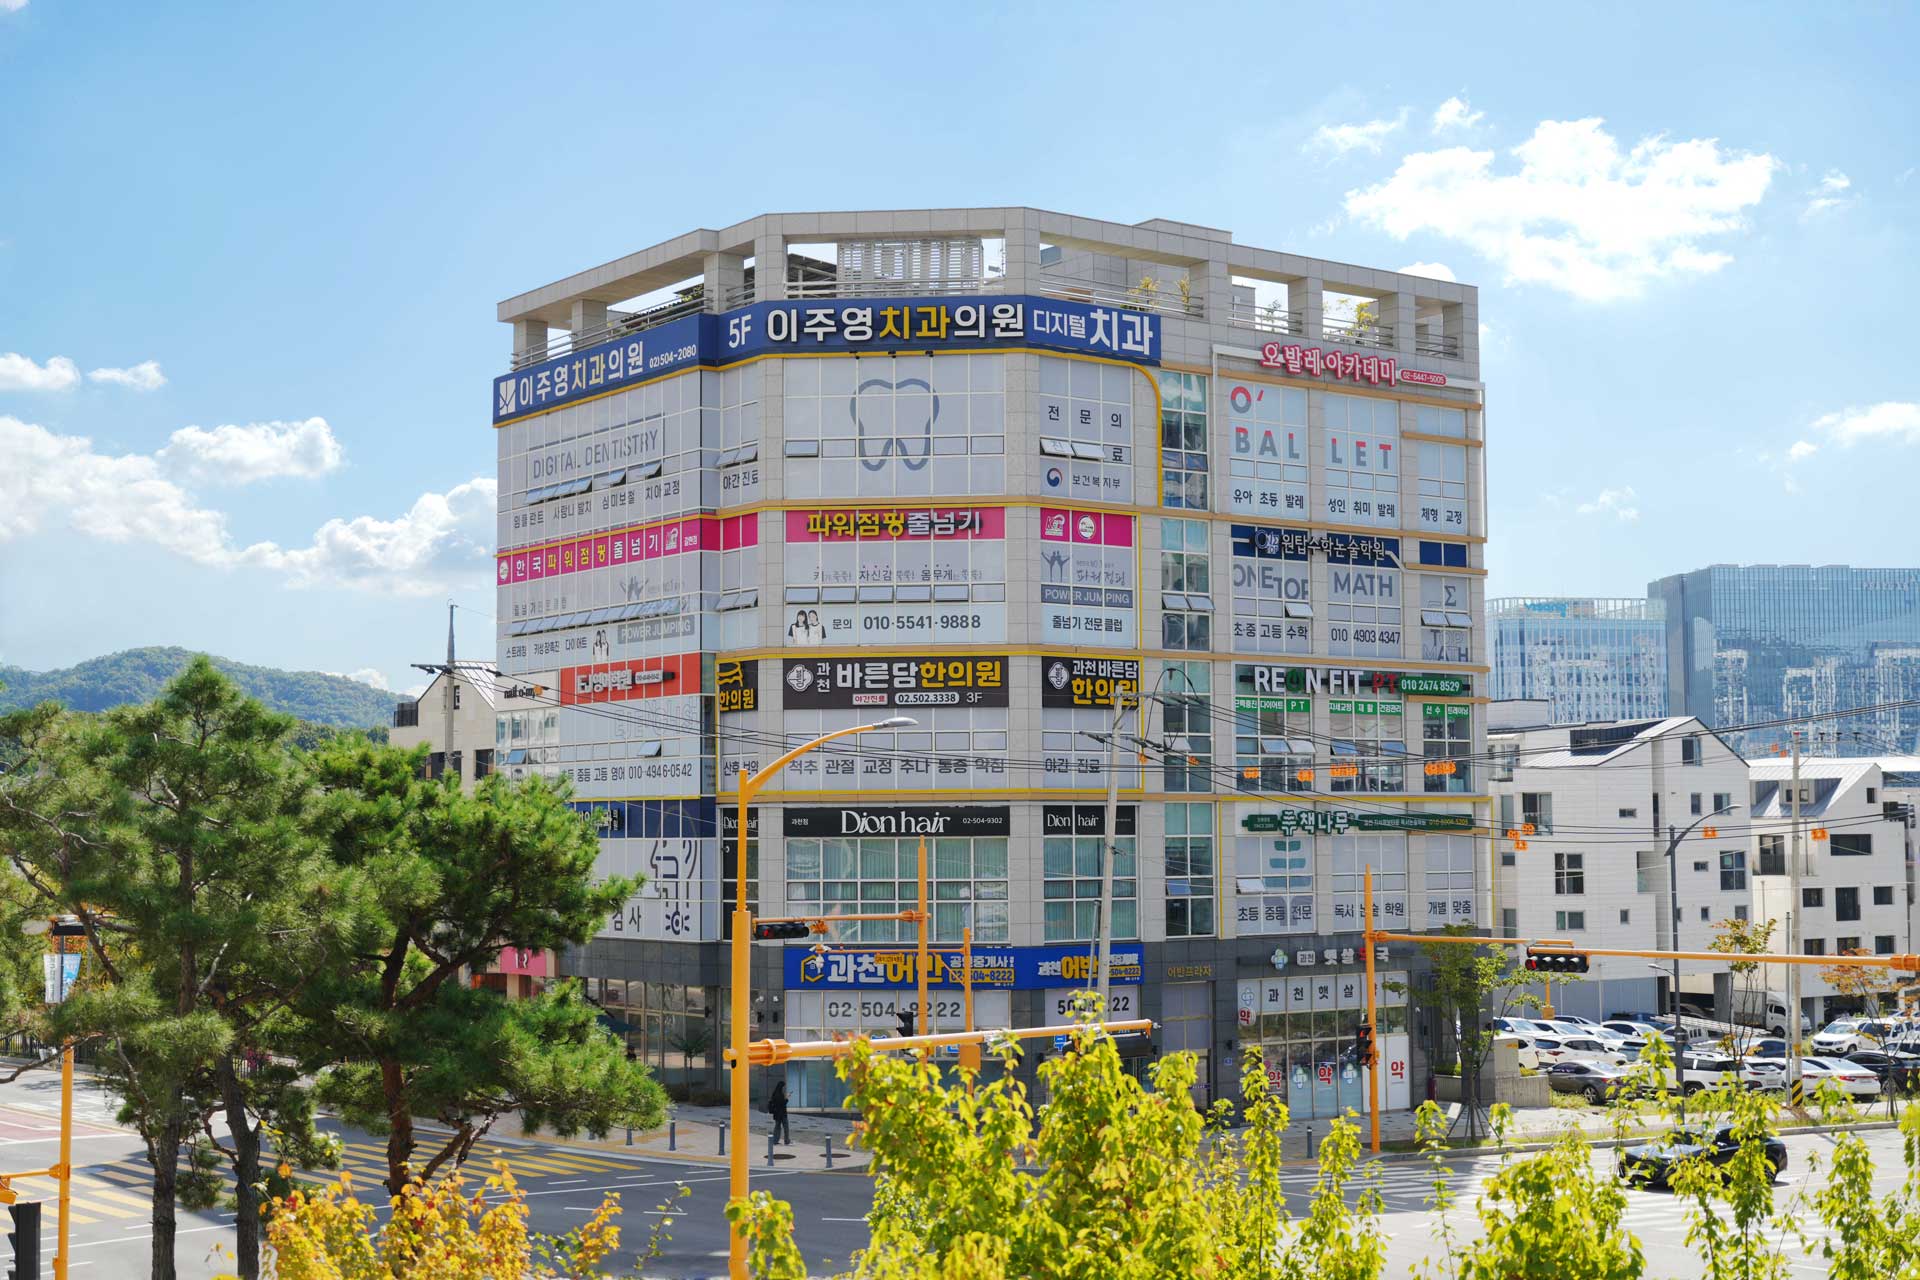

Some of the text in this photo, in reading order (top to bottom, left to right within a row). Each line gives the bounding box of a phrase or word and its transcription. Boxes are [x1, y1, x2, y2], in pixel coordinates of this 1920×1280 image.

[728, 314, 752, 349] 5F
[767, 303, 1154, 356] 이주영치과의원 디지털 치과
[520, 341, 697, 406] 이주영치과의원 02)504-2080
[533, 429, 659, 479] DIGITAL DENTISTRY
[1233, 489, 1304, 509] 유아 초등 발레
[1328, 498, 1396, 518] 성인 취미 발레
[1421, 507, 1462, 524] 체형 교정
[1334, 571, 1393, 597] MATH
[1045, 588, 1130, 604] POWER JUMPING
[832, 618, 852, 630] 문의
[1260, 623, 1282, 638] 고등
[1286, 625, 1308, 640] 수학
[1072, 660, 1097, 676] 과천
[1098, 661, 1138, 679] 바른담
[1329, 669, 1364, 695] FIT
[1372, 673, 1397, 694] PT
[719, 687, 754, 711] 한의원
[897, 693, 956, 704] 02.502.3338
[966, 692, 983, 704] 3F
[723, 761, 740, 776] 산후
[789, 759, 819, 776] 척추
[825, 759, 855, 775] 관절
[863, 759, 893, 775] 교정
[899, 758, 930, 775] 추나
[840, 810, 898, 834] Dion
[900, 810, 952, 834] hair
[1047, 813, 1099, 828] Dion hair
[1237, 905, 1312, 921] 초등 중등 전문
[1335, 903, 1354, 918] 독서
[1385, 902, 1404, 916] 학원
[1427, 900, 1472, 915] 개별 맞춤
[1240, 1008, 1251, 1024] 약
[1318, 1066, 1333, 1085] 약
[1391, 1061, 1404, 1079] 약
[1268, 1072, 1281, 1088] 약
